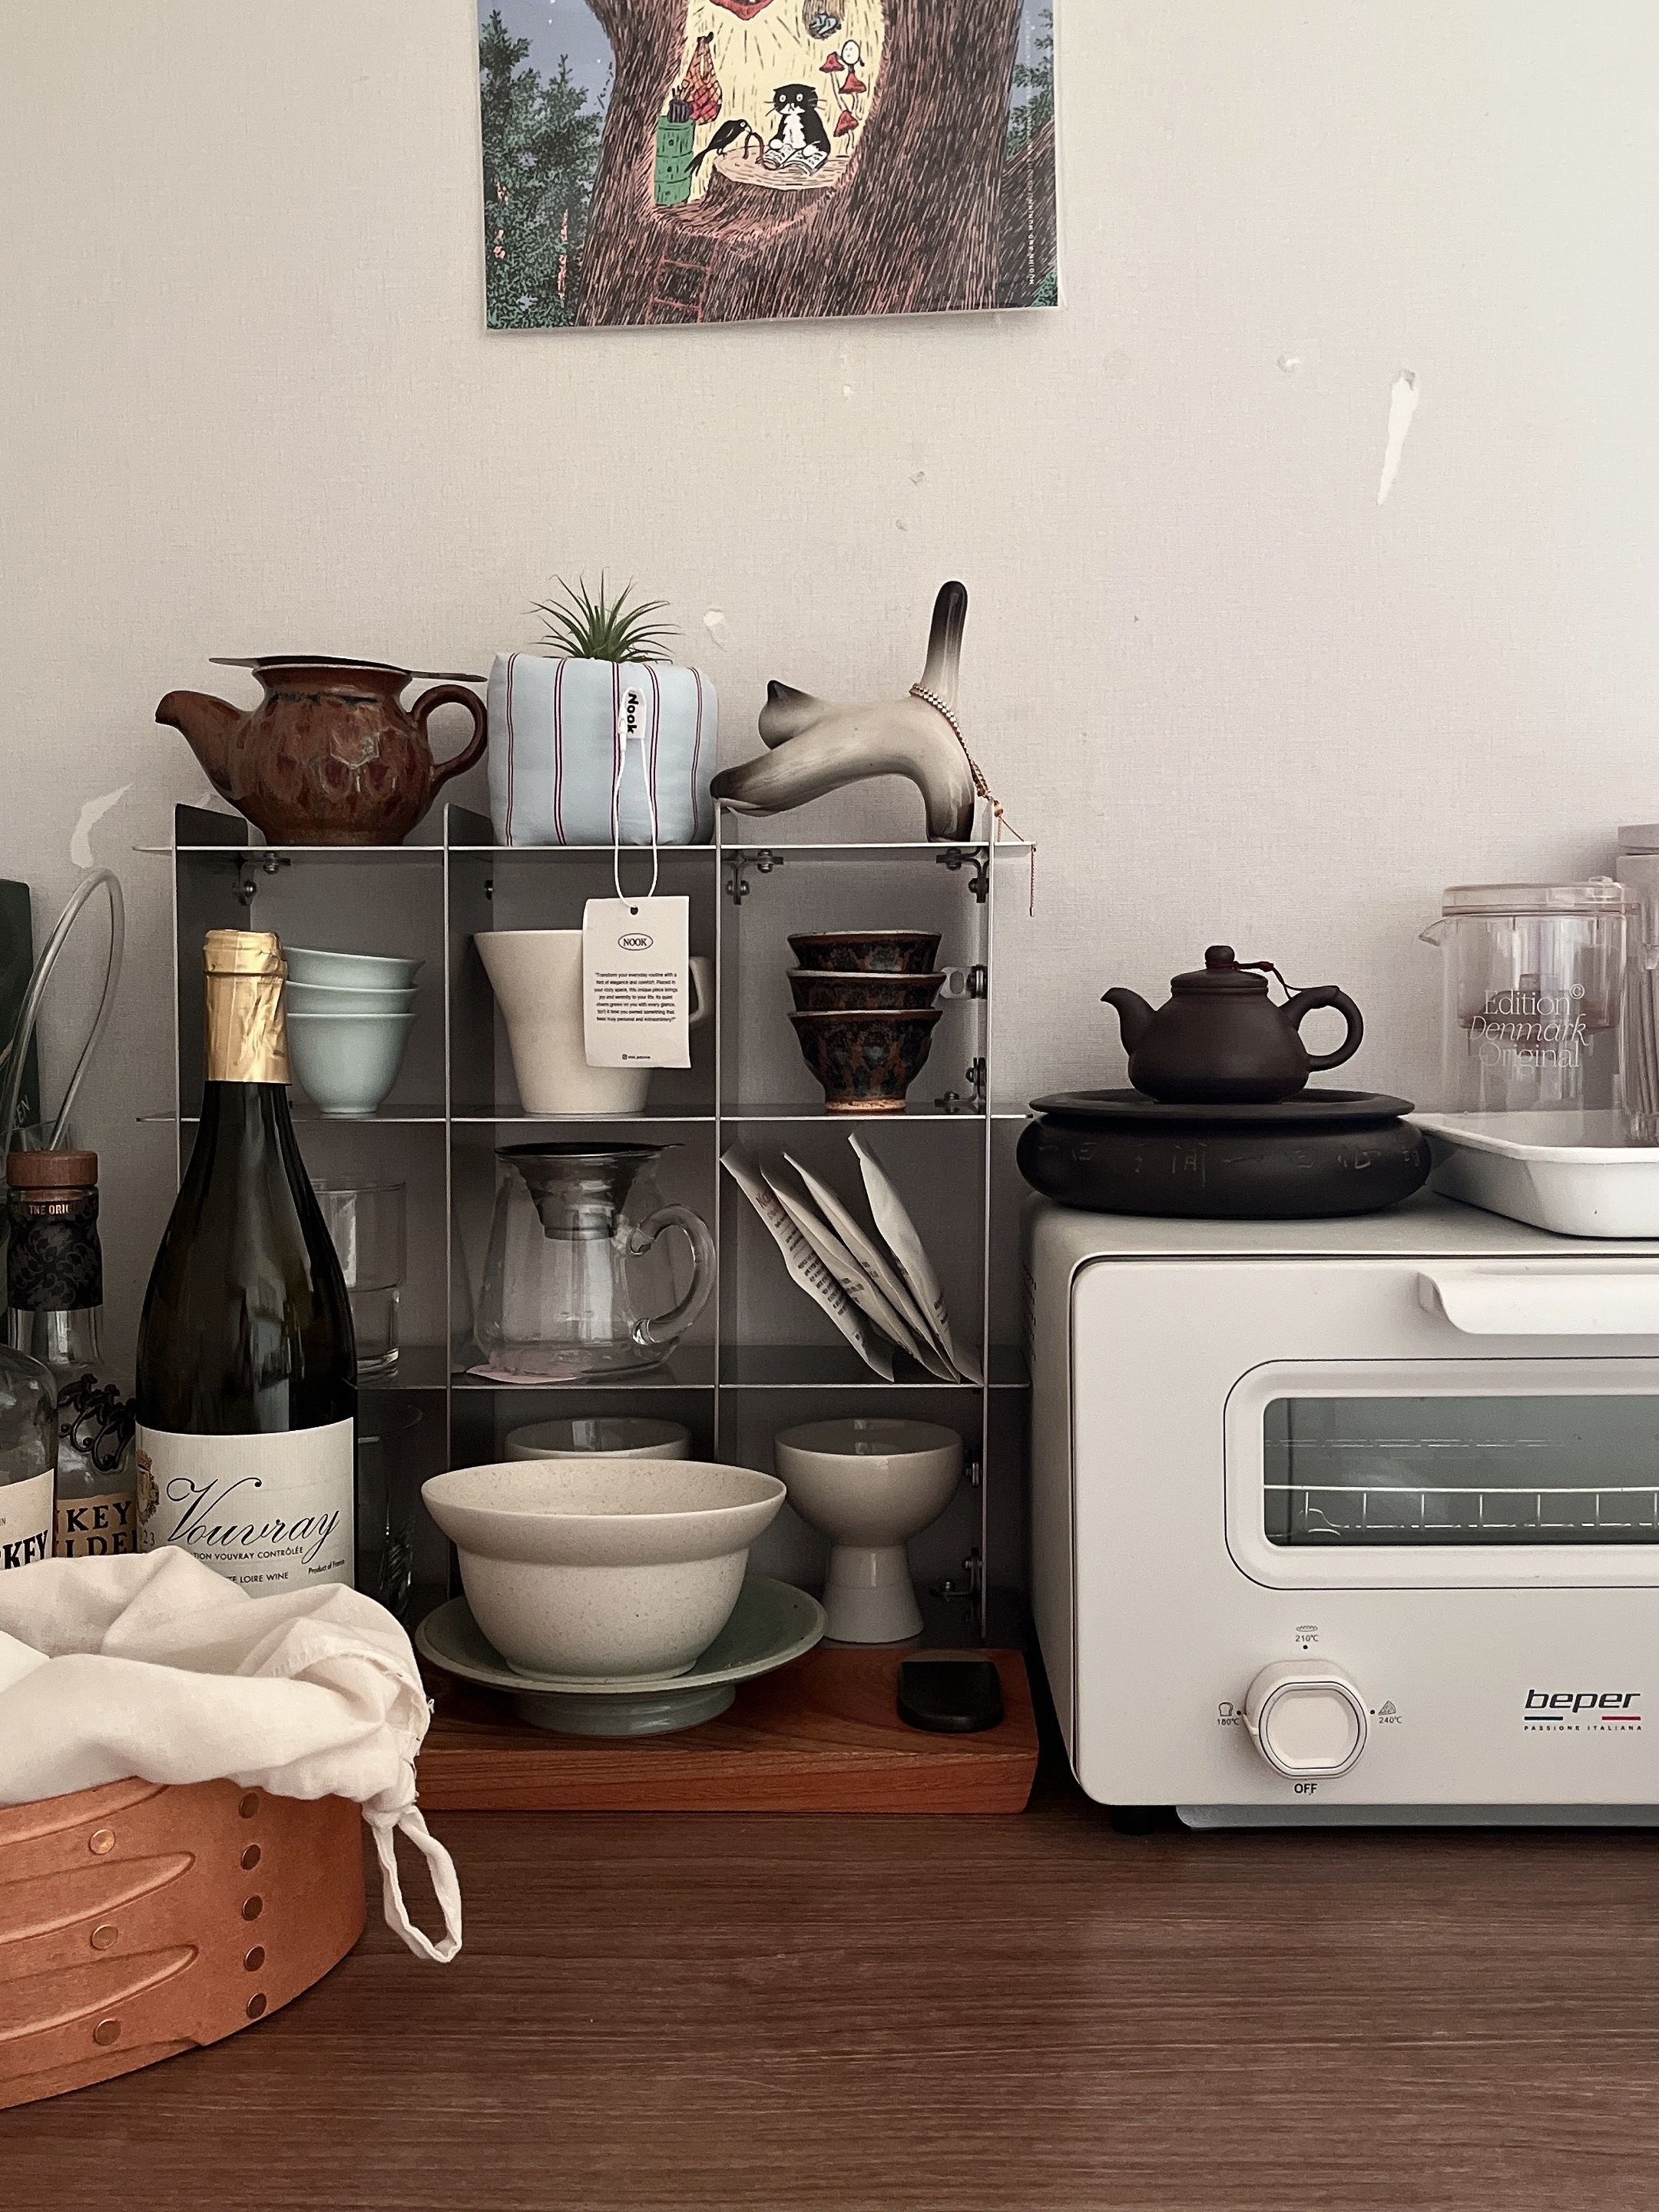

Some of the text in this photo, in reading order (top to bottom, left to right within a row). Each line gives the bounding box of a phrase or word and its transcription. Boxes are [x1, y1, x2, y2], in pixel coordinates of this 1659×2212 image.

[627, 693, 639, 733] Nook
[1469, 1013, 1590, 1046] Denmark
[1479, 1038, 1580, 1075] Original
[57, 1500, 131, 1533] KEY
[167, 1476, 340, 1565] Vouvray
[0, 1529, 48, 1569] KEY
[214, 1552, 254, 1561] VOUVRAY
[257, 1545, 303, 1559] CONTRÔLÉE
[240, 1575, 264, 1584] LOIRE
[266, 1571, 290, 1581] WINE
[308, 1565, 327, 1575] Product
[327, 1561, 332, 1569] of
[1525, 1689, 1641, 1714] beper
[1293, 1783, 1318, 1794] OFF
